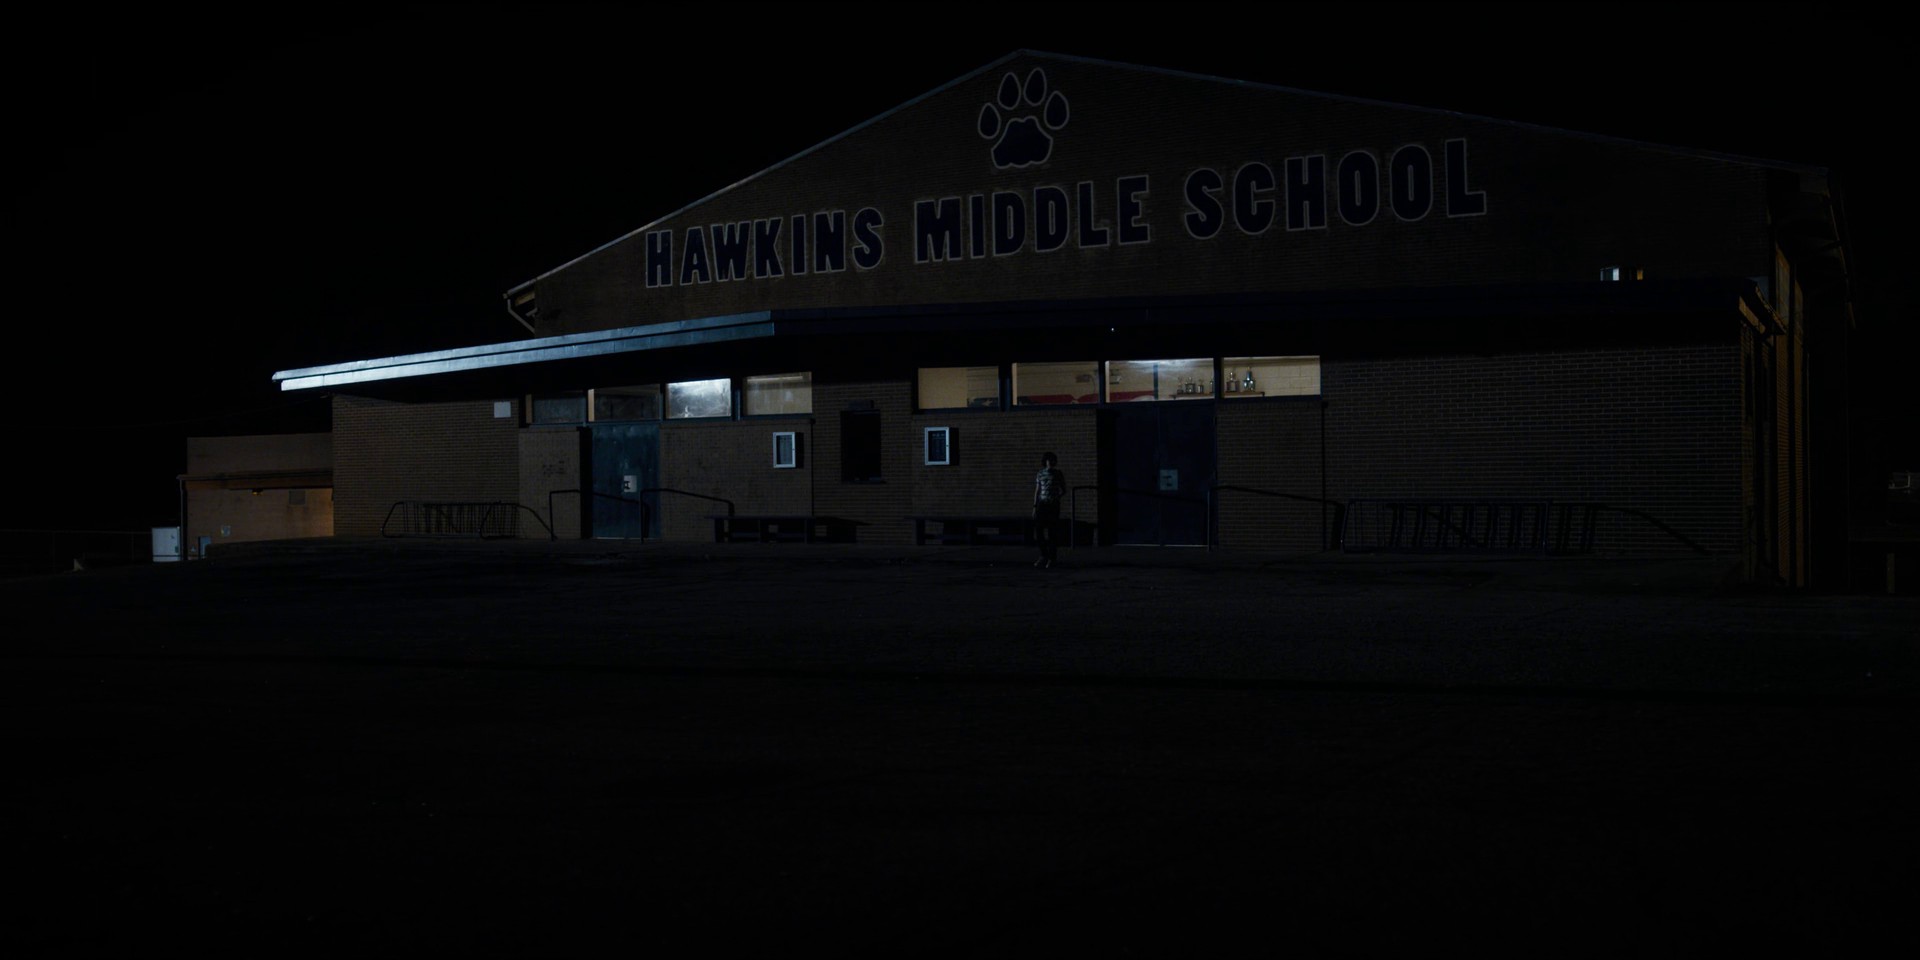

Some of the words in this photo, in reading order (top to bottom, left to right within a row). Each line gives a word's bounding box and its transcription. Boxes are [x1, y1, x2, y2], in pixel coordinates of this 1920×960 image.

[646, 207, 884, 288] HAWKINS
[914, 174, 1150, 264] MIDDLE
[1184, 138, 1487, 240] SCHOOL
